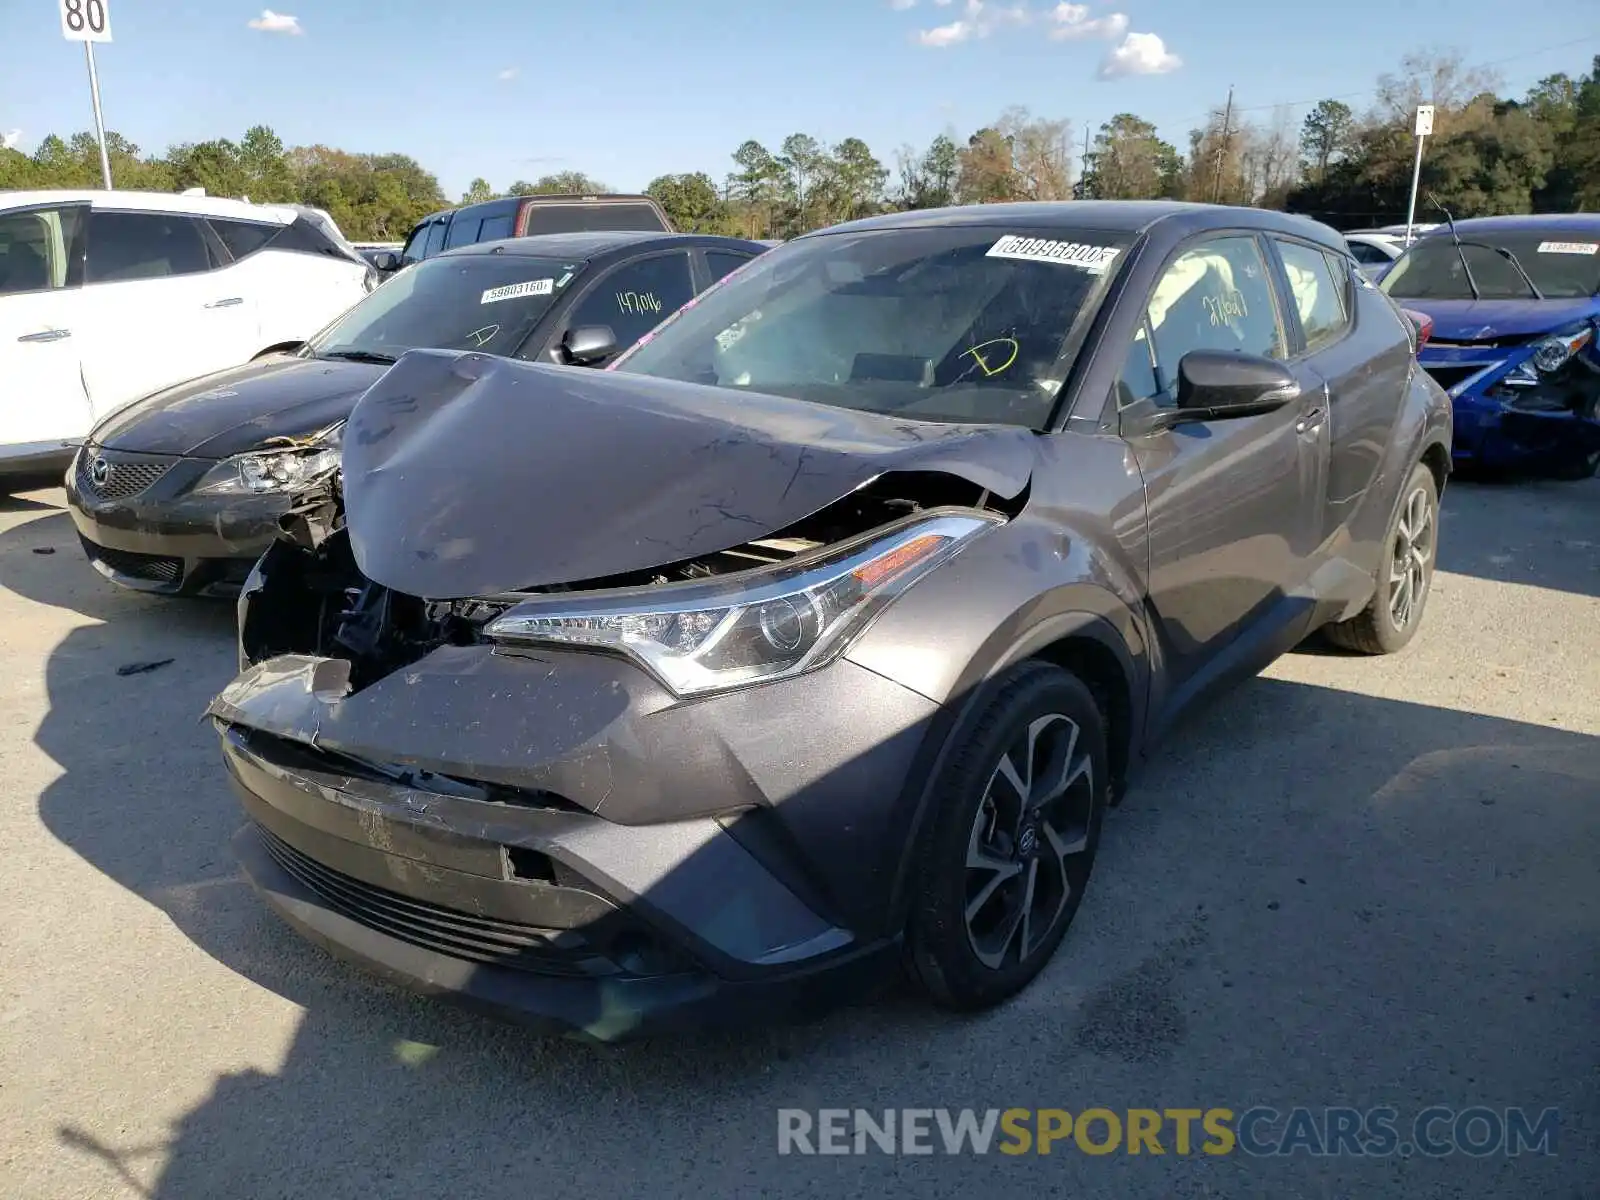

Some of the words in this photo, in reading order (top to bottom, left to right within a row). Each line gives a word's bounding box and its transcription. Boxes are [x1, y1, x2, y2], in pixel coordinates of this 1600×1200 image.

[65, 0, 104, 33] 80
[465, 324, 500, 347] D
[958, 338, 1018, 377] D
